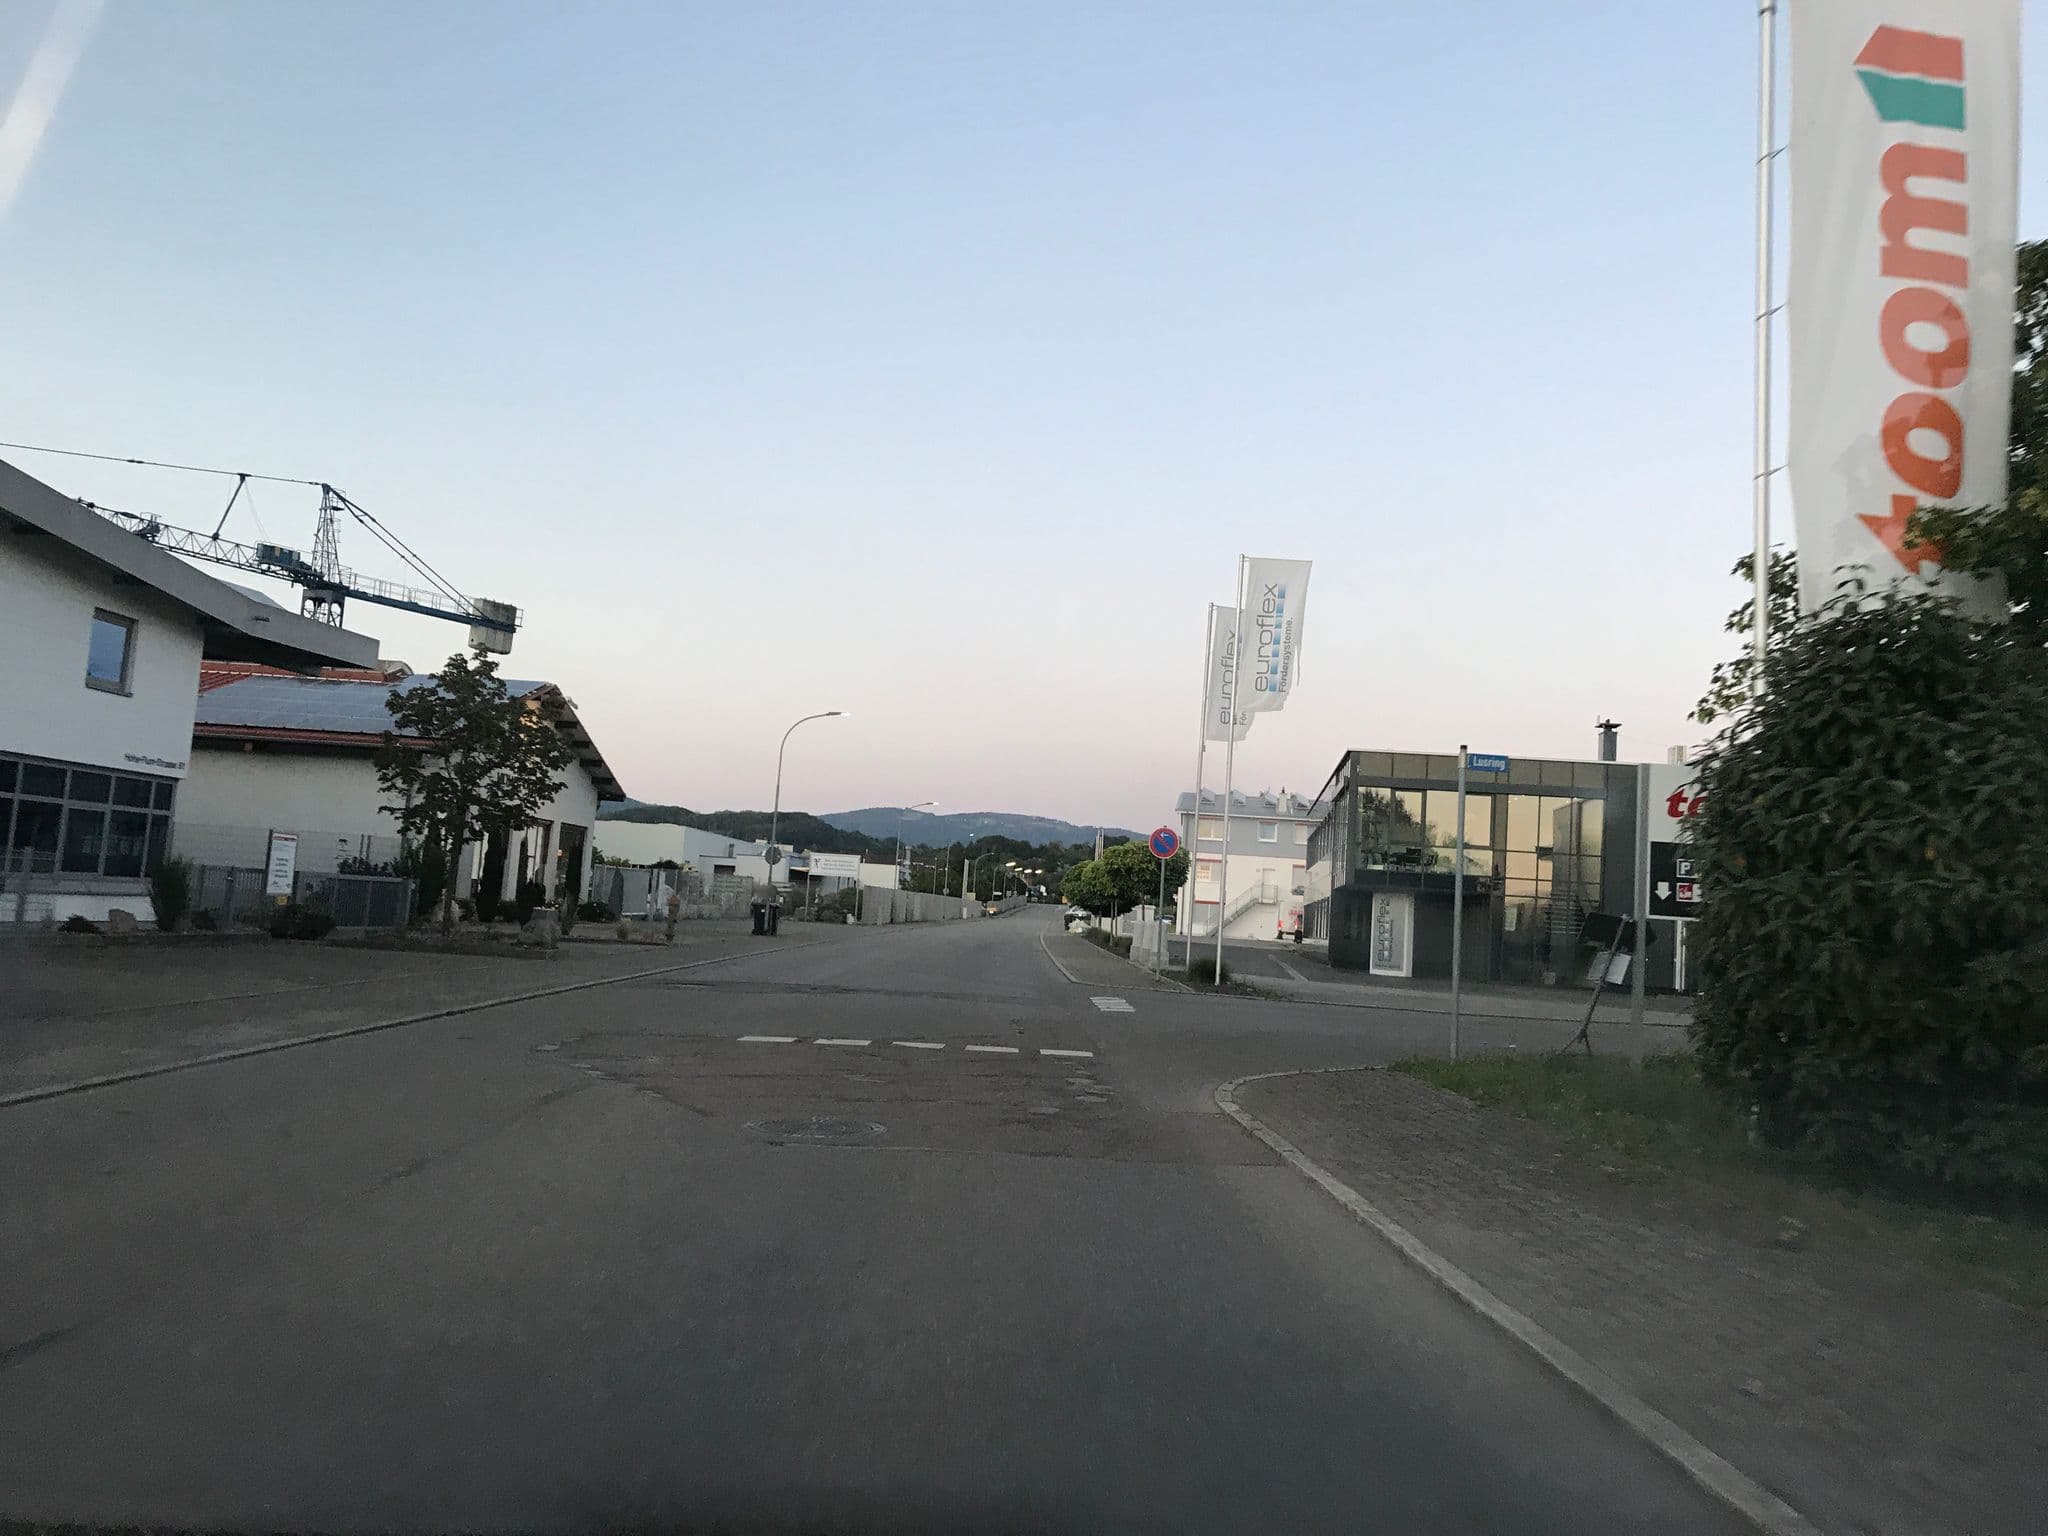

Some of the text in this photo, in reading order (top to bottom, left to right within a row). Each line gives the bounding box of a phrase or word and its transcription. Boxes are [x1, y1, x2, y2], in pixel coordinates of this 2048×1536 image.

[1855, 142, 1971, 575] toom
[1255, 583, 1277, 692] euroflex
[1473, 756, 1505, 771] Lusring
